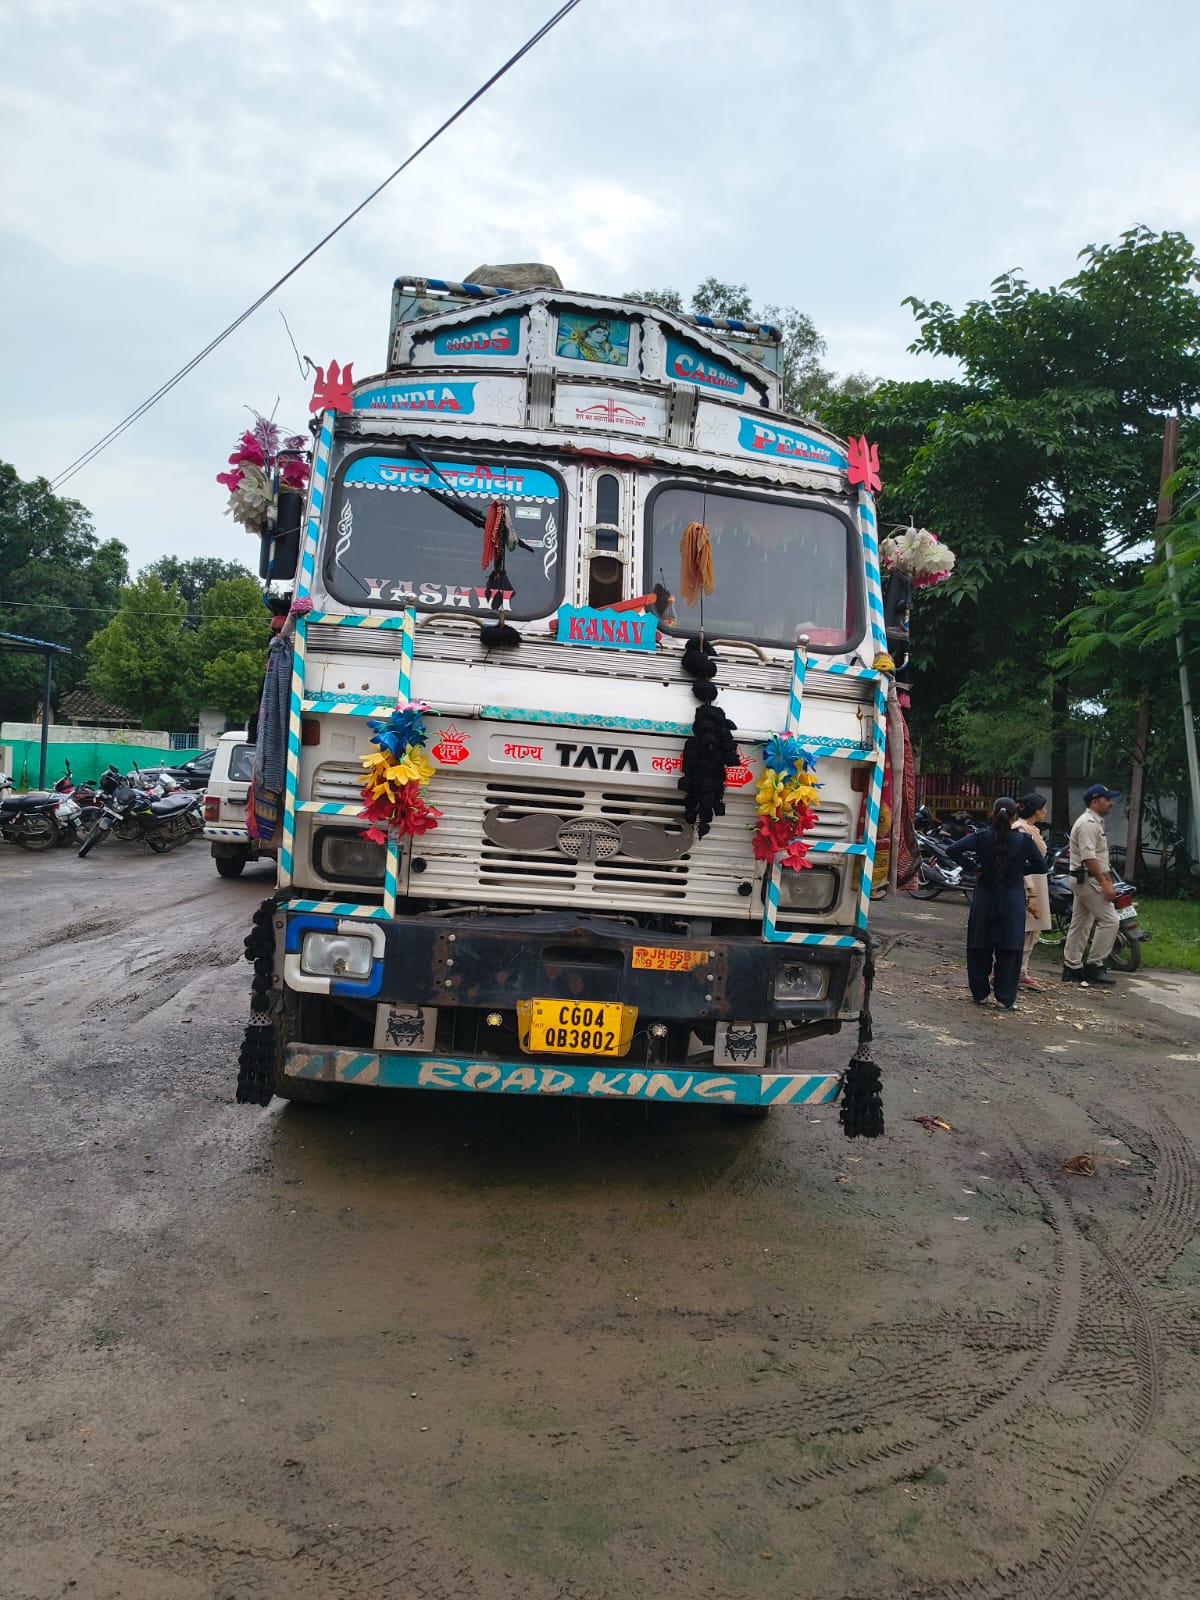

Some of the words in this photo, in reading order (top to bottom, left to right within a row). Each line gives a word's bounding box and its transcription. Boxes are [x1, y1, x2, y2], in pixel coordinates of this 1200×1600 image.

[446, 328, 510, 351] GOODS
[674, 354, 738, 389] CARRIER
[370, 395, 388, 408] ALL
[391, 387, 462, 410] INDIA
[752, 424, 830, 462] PERMIT
[378, 465, 431, 485] जय
[364, 577, 514, 612] YASHVI
[569, 616, 645, 645] KANAV
[504, 743, 544, 760] भाग्य
[555, 742, 639, 772] TATA
[559, 1006, 605, 1028] CG04
[545, 1027, 615, 1051] QB3802
[417, 1060, 576, 1094] ROAD
[587, 1070, 738, 1102] KING
